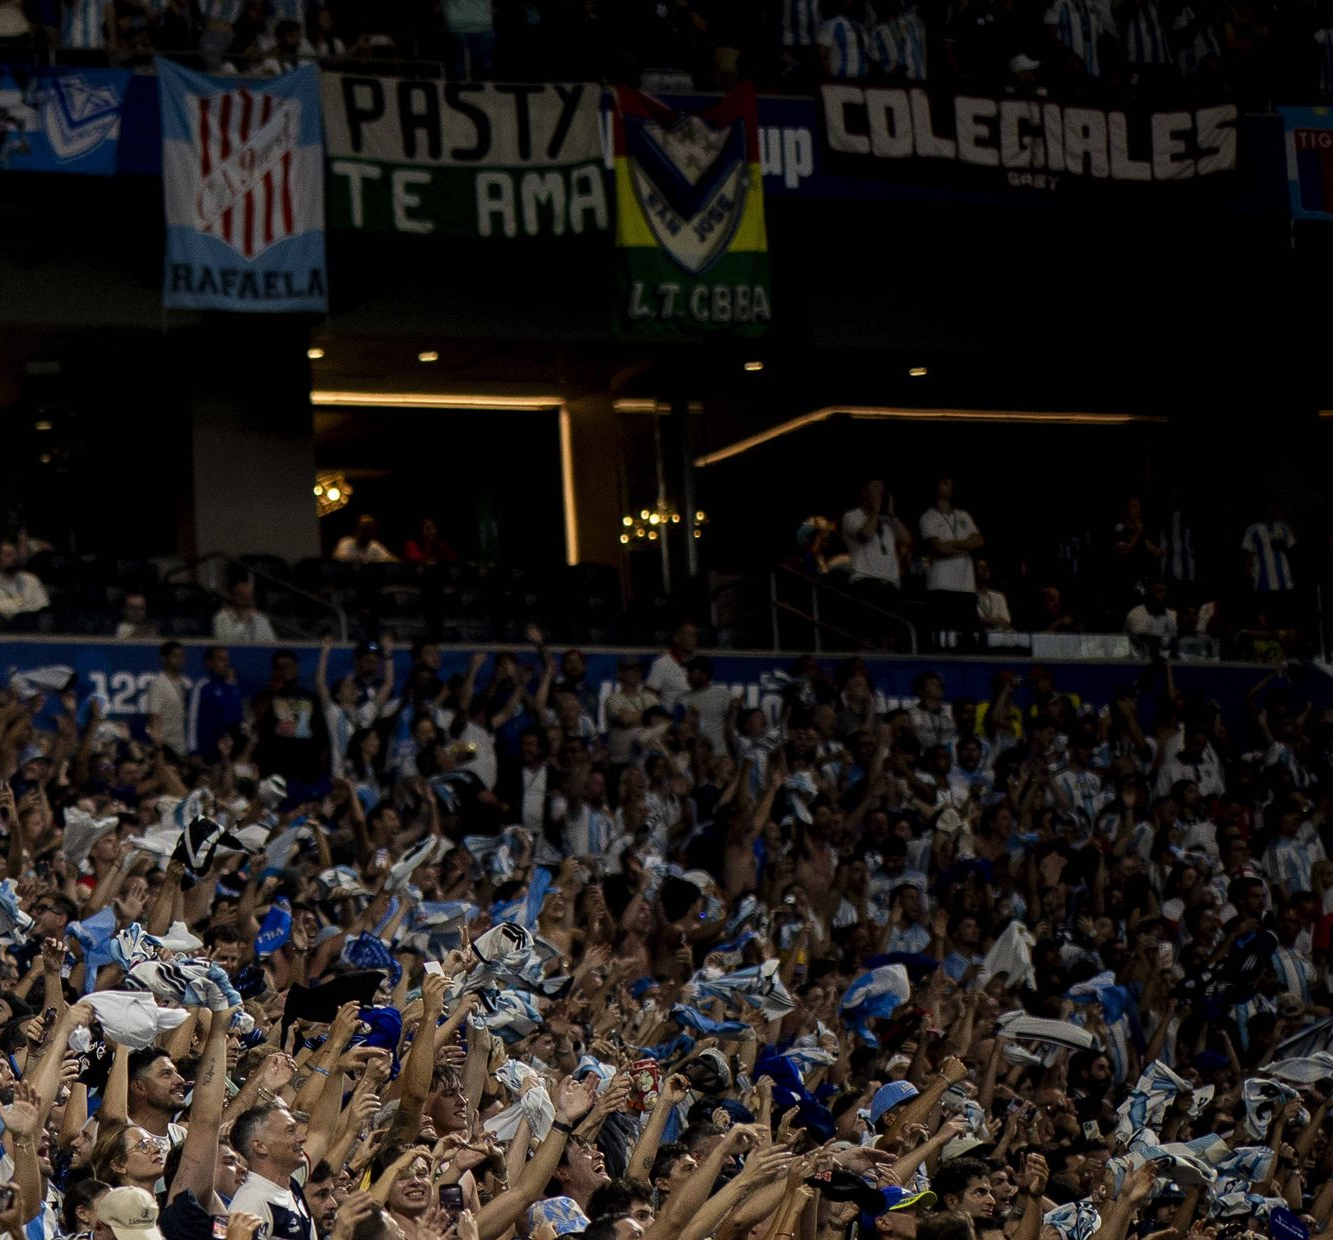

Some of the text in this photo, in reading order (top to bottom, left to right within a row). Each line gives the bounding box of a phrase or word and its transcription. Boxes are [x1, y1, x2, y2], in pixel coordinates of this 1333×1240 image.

[341, 77, 584, 163] PASTY
[820, 83, 1238, 182] COLEGIALES
[331, 163, 435, 234] TE
[476, 166, 609, 239] AMA
[169, 261, 325, 300] RAFAELA
